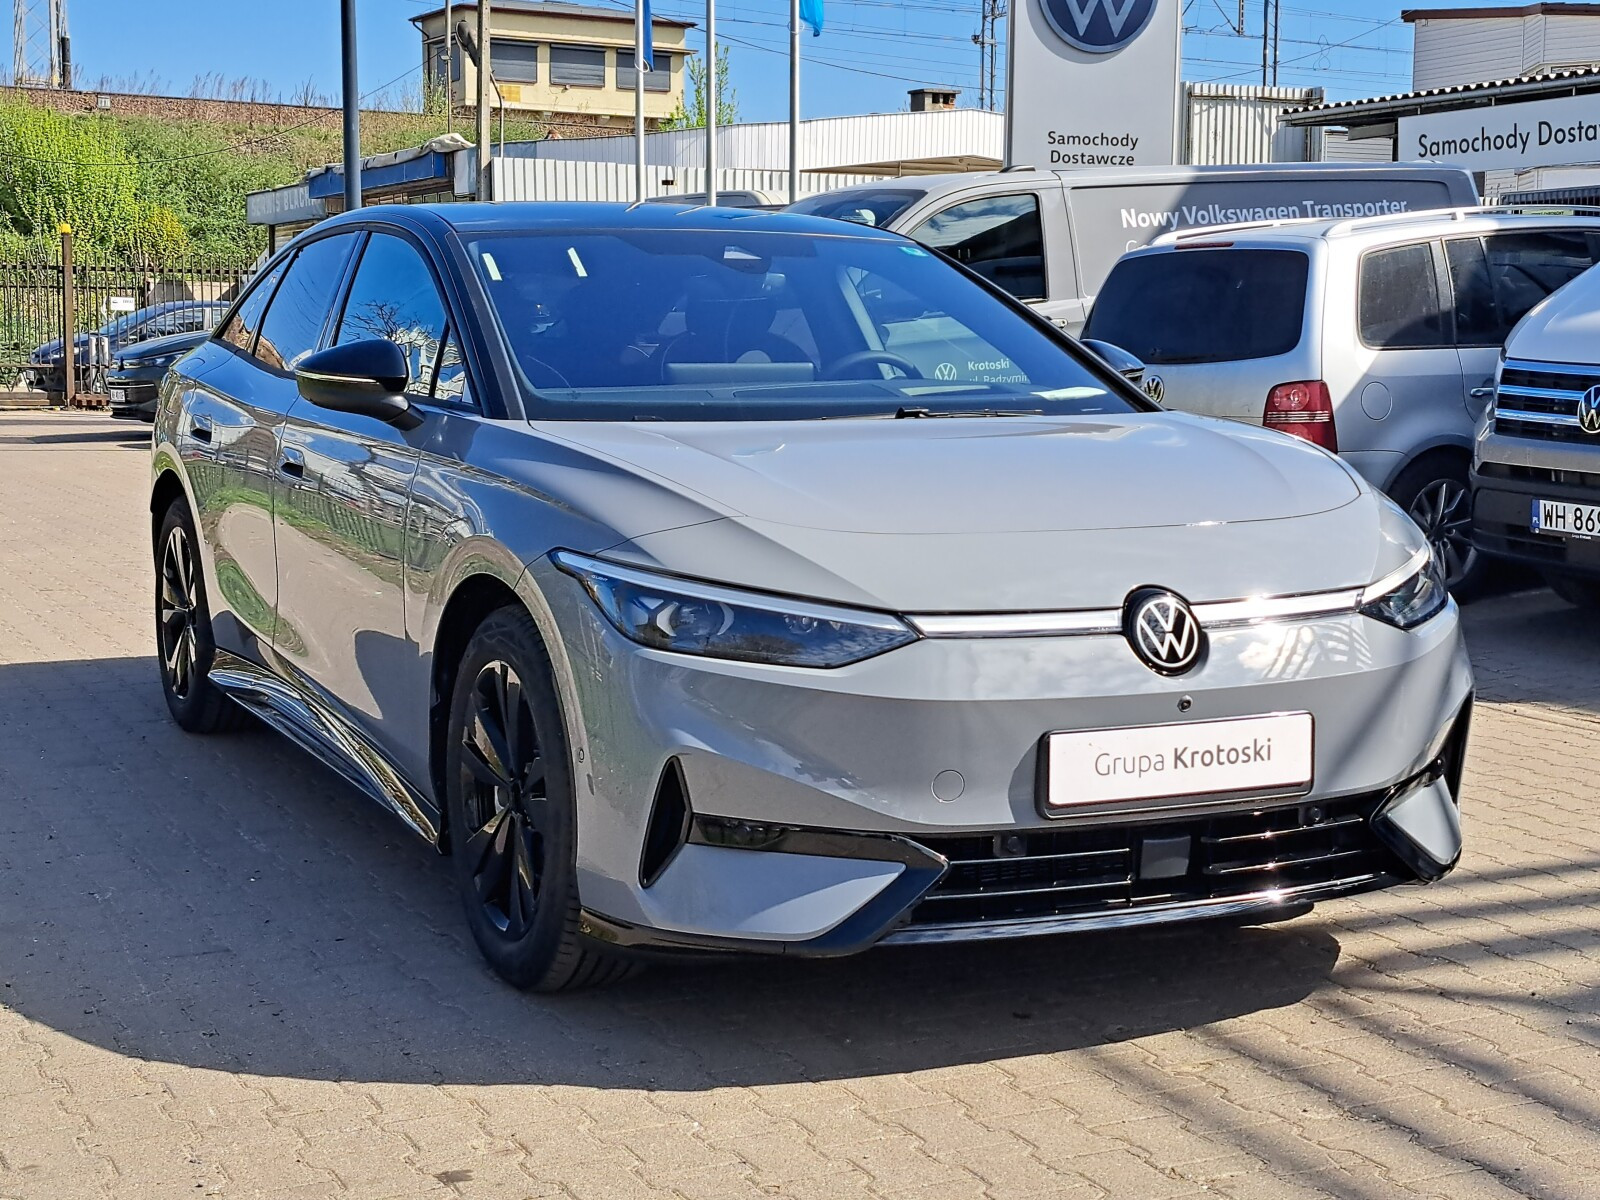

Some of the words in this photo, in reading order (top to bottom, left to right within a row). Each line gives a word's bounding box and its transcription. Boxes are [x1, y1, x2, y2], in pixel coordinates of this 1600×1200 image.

[1047, 131, 1139, 151] Samochody
[1418, 122, 1531, 158] Samochody
[1538, 120, 1600, 146] Dosta
[1050, 149, 1135, 166] Dostawcze
[1120, 208, 1180, 231] Nowy
[1182, 204, 1300, 224] Volkswagen
[967, 358, 1010, 371] Krotoski
[1543, 503, 1566, 530] WH
[1094, 751, 1165, 779] Grupa
[1173, 738, 1272, 770] Krotoski
